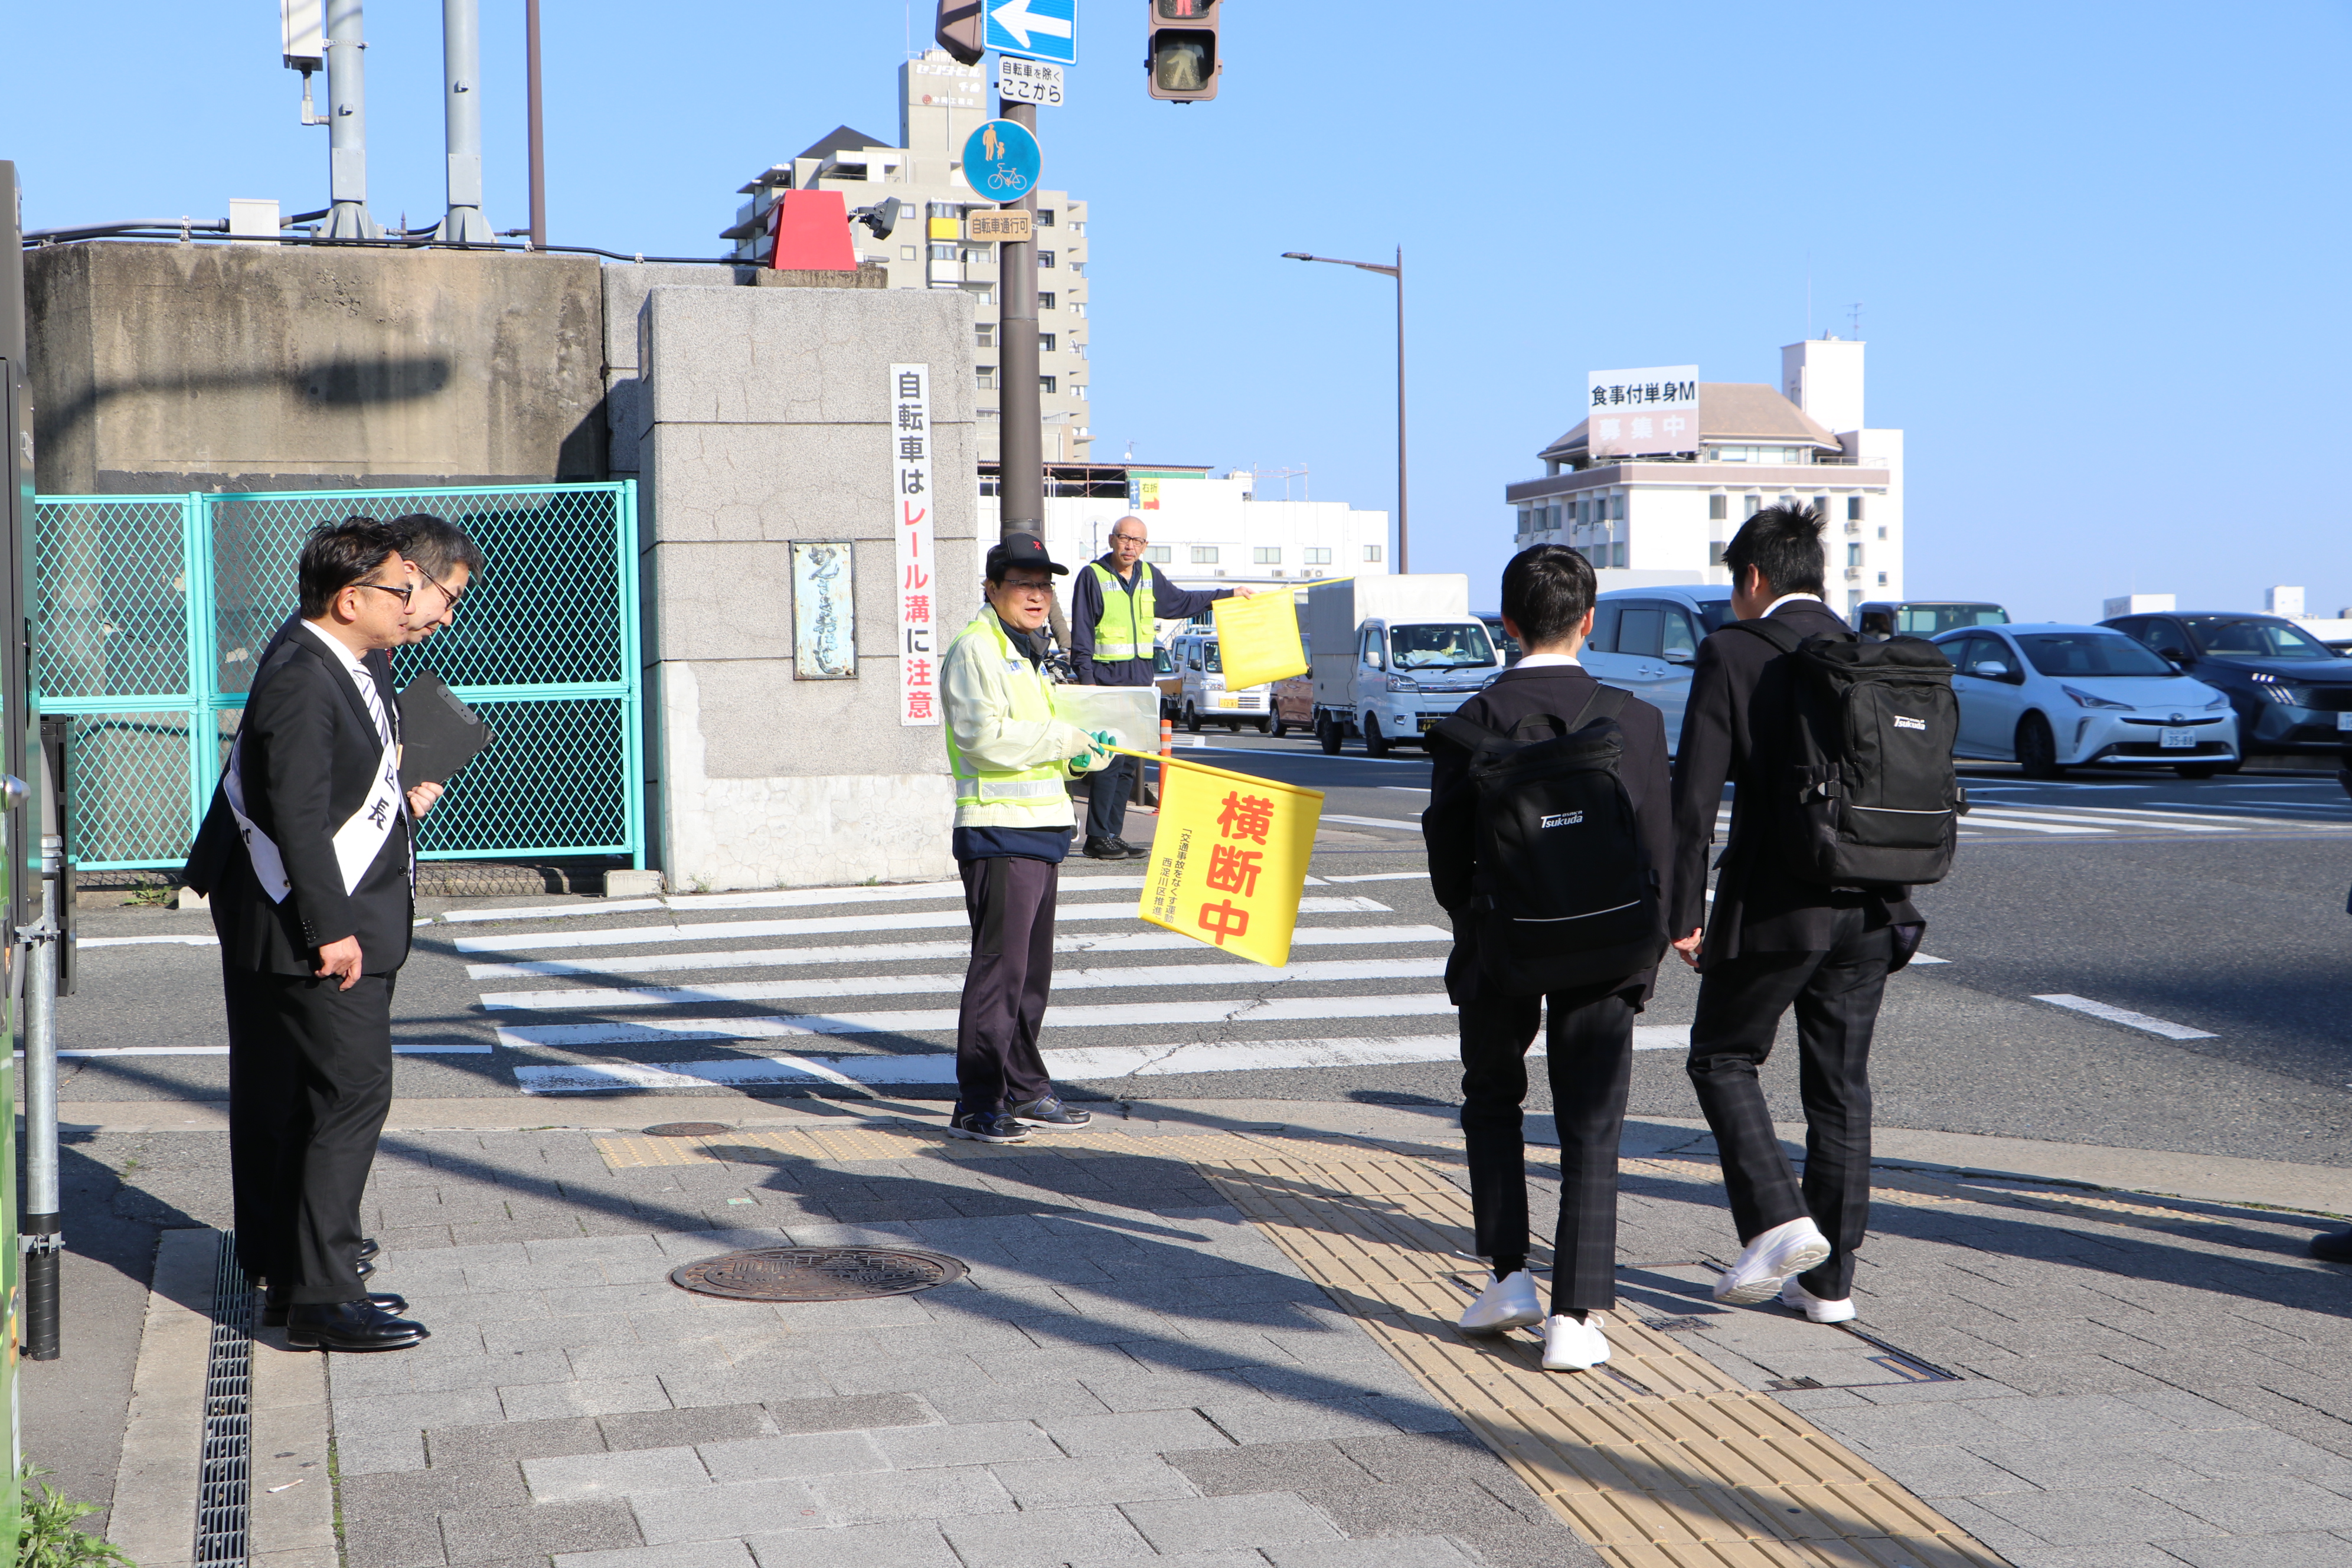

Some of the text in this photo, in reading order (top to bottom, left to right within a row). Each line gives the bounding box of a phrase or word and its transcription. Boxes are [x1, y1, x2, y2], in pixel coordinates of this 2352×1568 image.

[1002, 61, 1060, 83] 自転車を除く
[1002, 79, 1061, 103] ここから
[972, 217, 1028, 234] 自転車通行可
[1591, 381, 1696, 406] 食事付単身M
[1599, 414, 1686, 440] 募集中
[1142, 483, 1158, 492] 右折
[898, 371, 933, 719] 自転車はレール溝に注意
[1894, 716, 1926, 730] Tsukuda
[1541, 814, 1583, 828] Tsukuda
[1164, 828, 1193, 923] 「交通事故をなくす運動
[1197, 790, 1275, 946] 横断中
